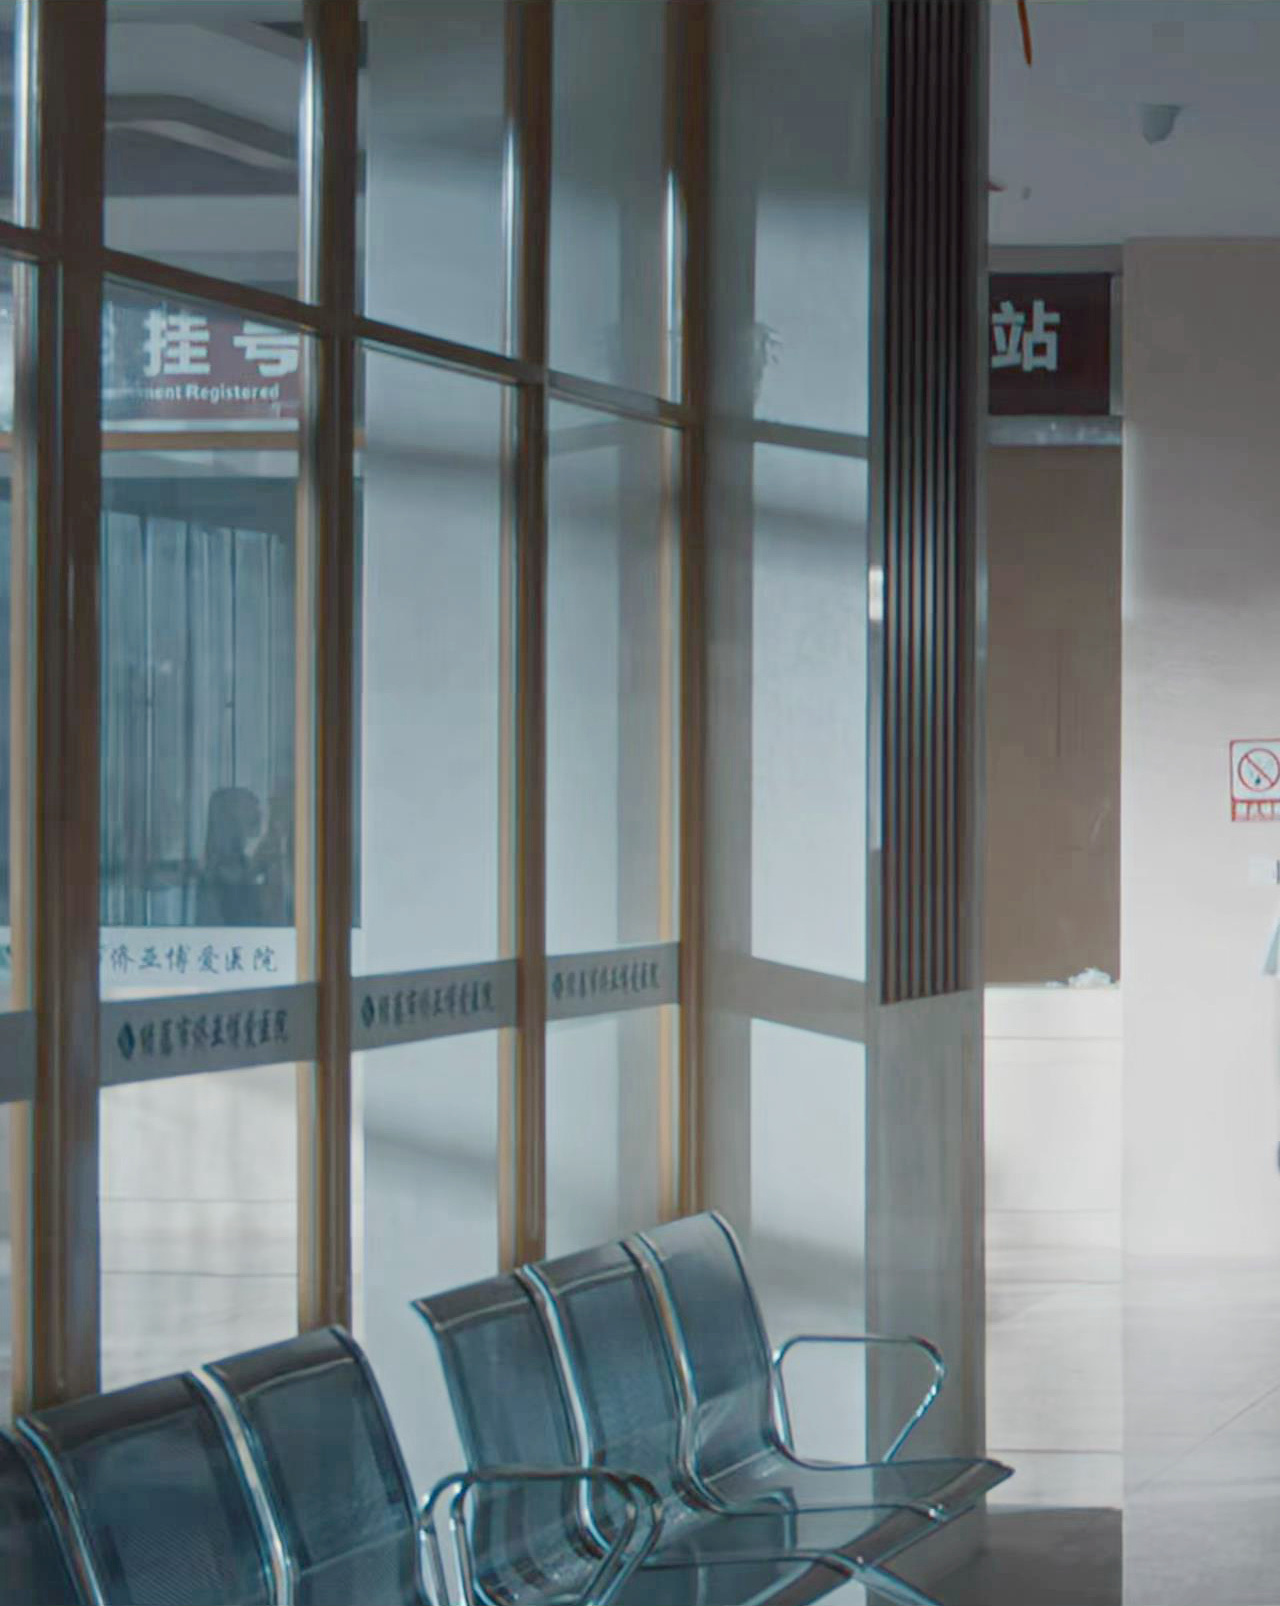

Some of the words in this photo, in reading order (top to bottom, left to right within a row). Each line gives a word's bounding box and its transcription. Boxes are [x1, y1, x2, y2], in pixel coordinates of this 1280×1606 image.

[991, 300, 1061, 372] 站
[184, 383, 280, 404] Registered
[101, 944, 277, 974] 侨亚博爱医院
